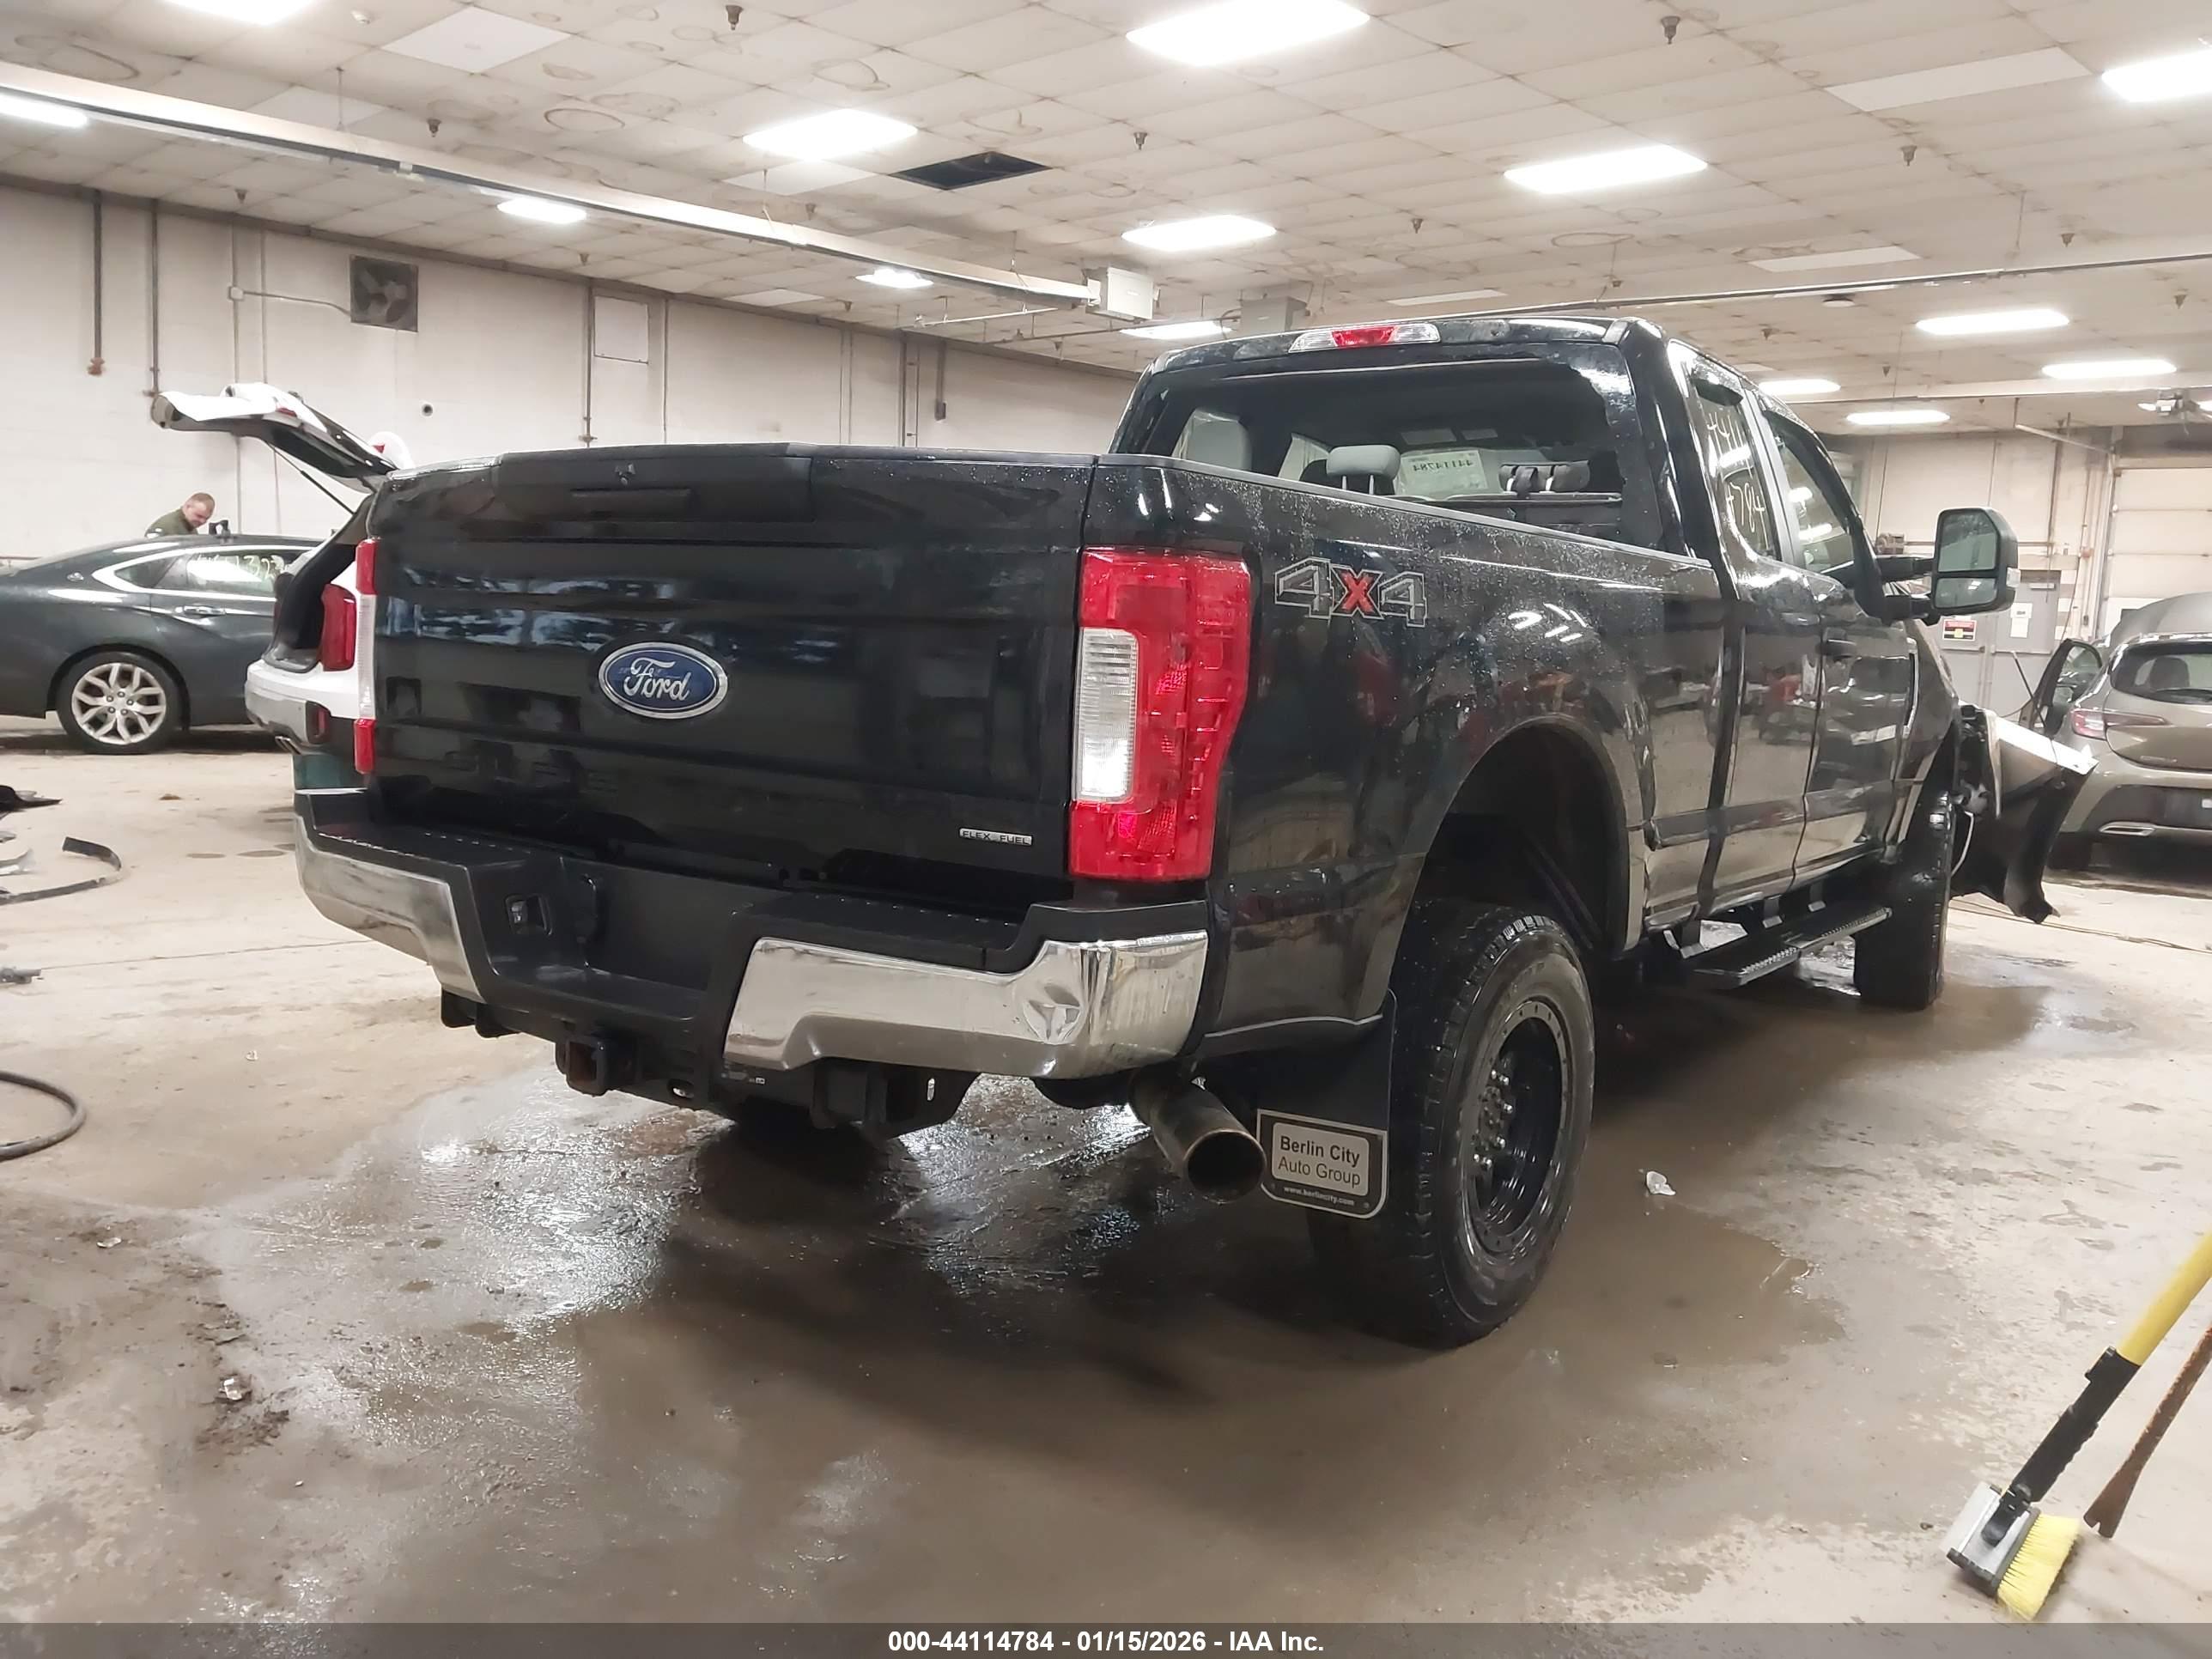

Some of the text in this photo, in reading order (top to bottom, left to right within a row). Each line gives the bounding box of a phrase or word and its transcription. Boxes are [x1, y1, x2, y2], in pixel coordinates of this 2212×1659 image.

[623, 657, 692, 701] Ford
[963, 830, 1030, 846] FLEX FUEL
[1280, 1135, 1360, 1168] Berlin City
[1278, 1156, 1361, 1188] Auto Group
